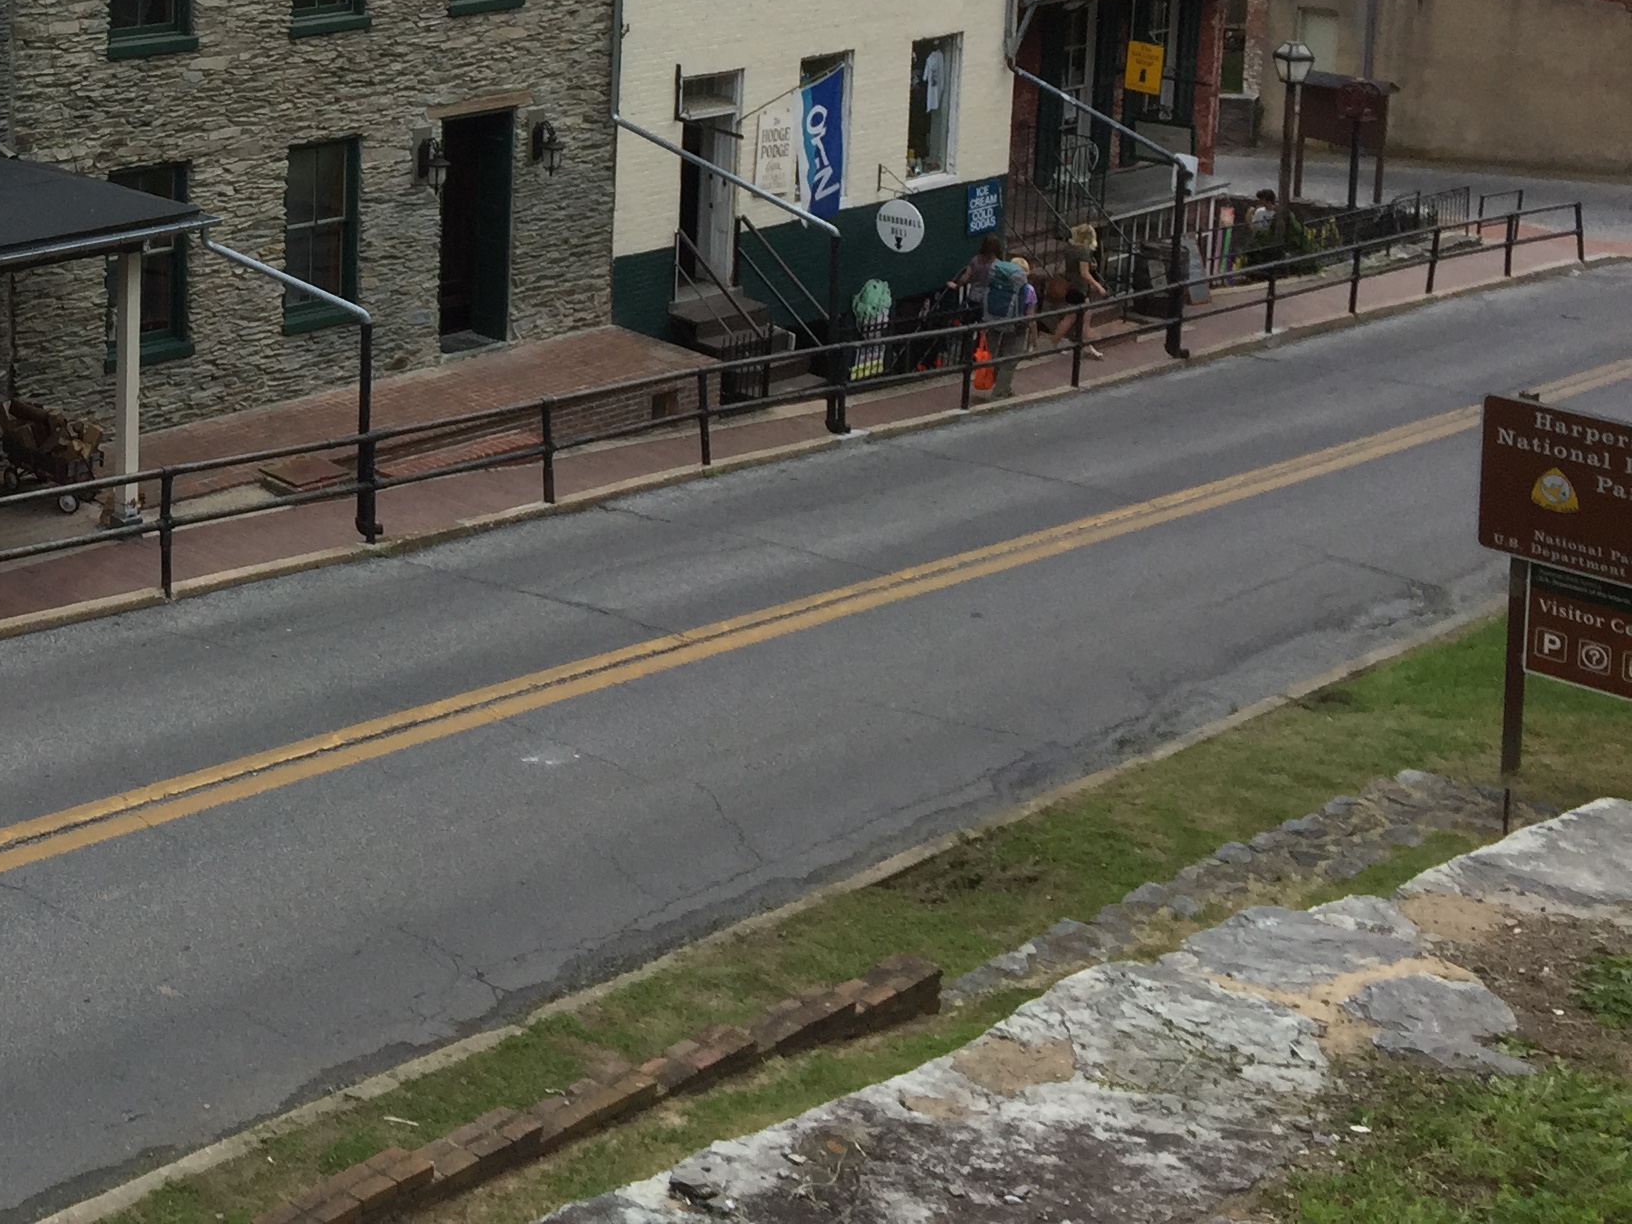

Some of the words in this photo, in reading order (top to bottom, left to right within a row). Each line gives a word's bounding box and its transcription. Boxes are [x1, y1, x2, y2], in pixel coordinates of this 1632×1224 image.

[761, 127, 791, 143] HODGE
[760, 143, 789, 160] PODGE
[976, 185, 990, 195] ICE
[969, 194, 998, 209] CREAM
[970, 216, 997, 232] SODAS
[971, 208, 994, 222] COLD
[1534, 411, 1632, 448] Harper
[1496, 426, 1612, 470] National
[1596, 475, 1632, 502] Pa
[1534, 529, 1603, 559] National
[1610, 549, 1632, 565] Pa
[1531, 543, 1626, 577] Department
[1539, 598, 1606, 630] Visitor
